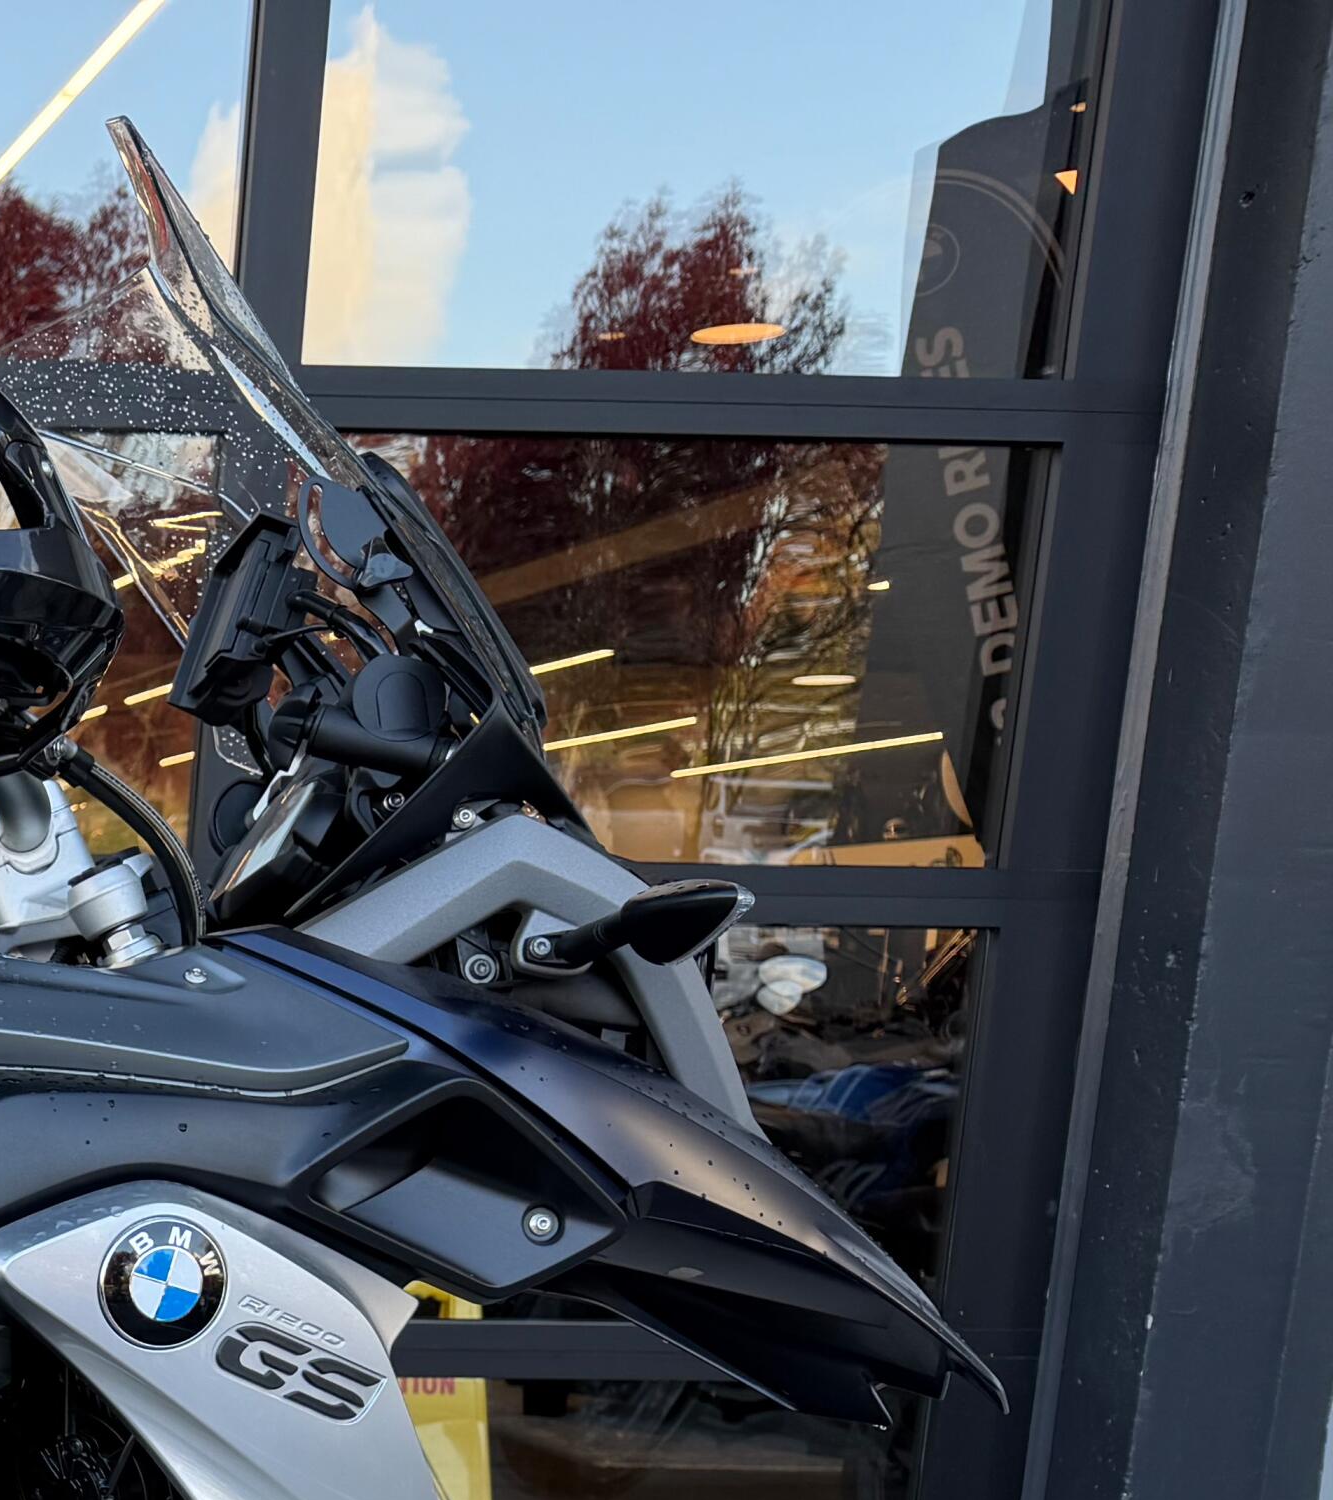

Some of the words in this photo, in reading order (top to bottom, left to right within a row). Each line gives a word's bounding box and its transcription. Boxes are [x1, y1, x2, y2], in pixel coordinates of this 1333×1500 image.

[954, 502, 1018, 677] DEMO
[129, 1226, 220, 1277] BMW
[216, 1325, 384, 1421] GS
